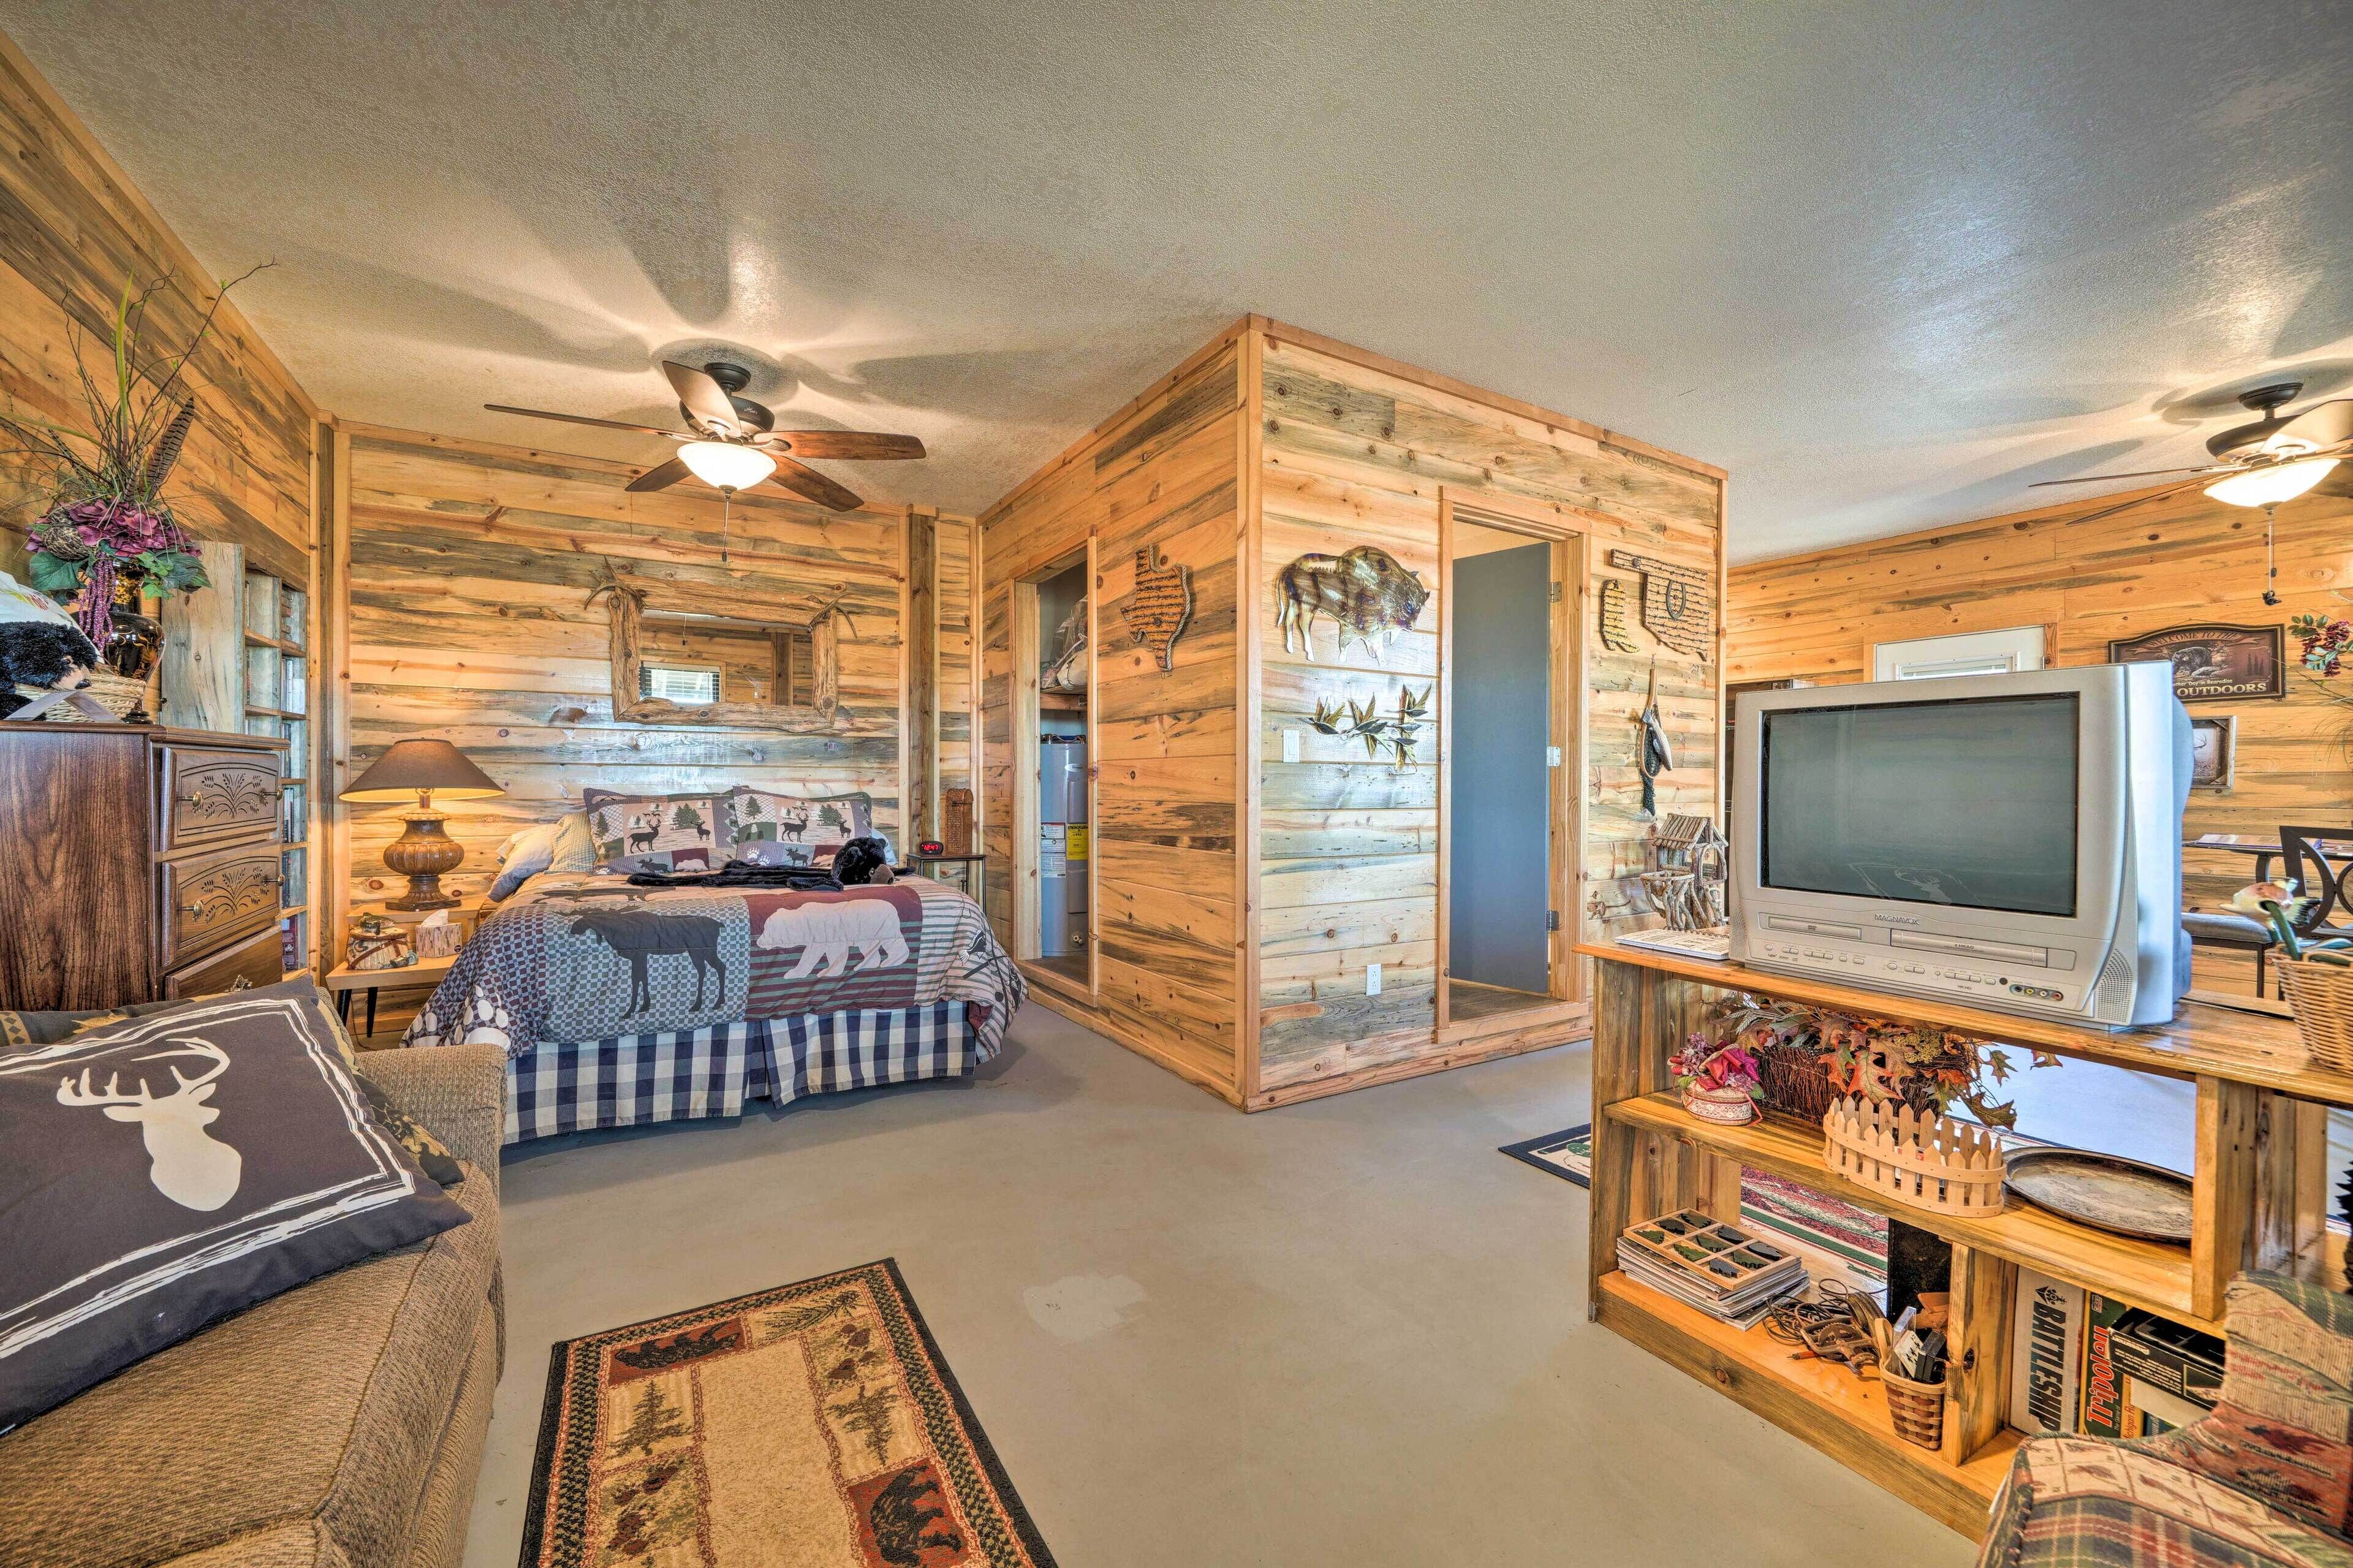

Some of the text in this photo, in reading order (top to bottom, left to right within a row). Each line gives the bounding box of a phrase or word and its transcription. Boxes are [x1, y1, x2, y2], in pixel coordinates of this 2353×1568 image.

[2147, 632, 2198, 648] WELCOME
[2177, 683, 2267, 697] OUTDOORS
[1874, 914, 1920, 925] MAGNAVOX
[2028, 1300, 2067, 1432] BATTLESHIP
